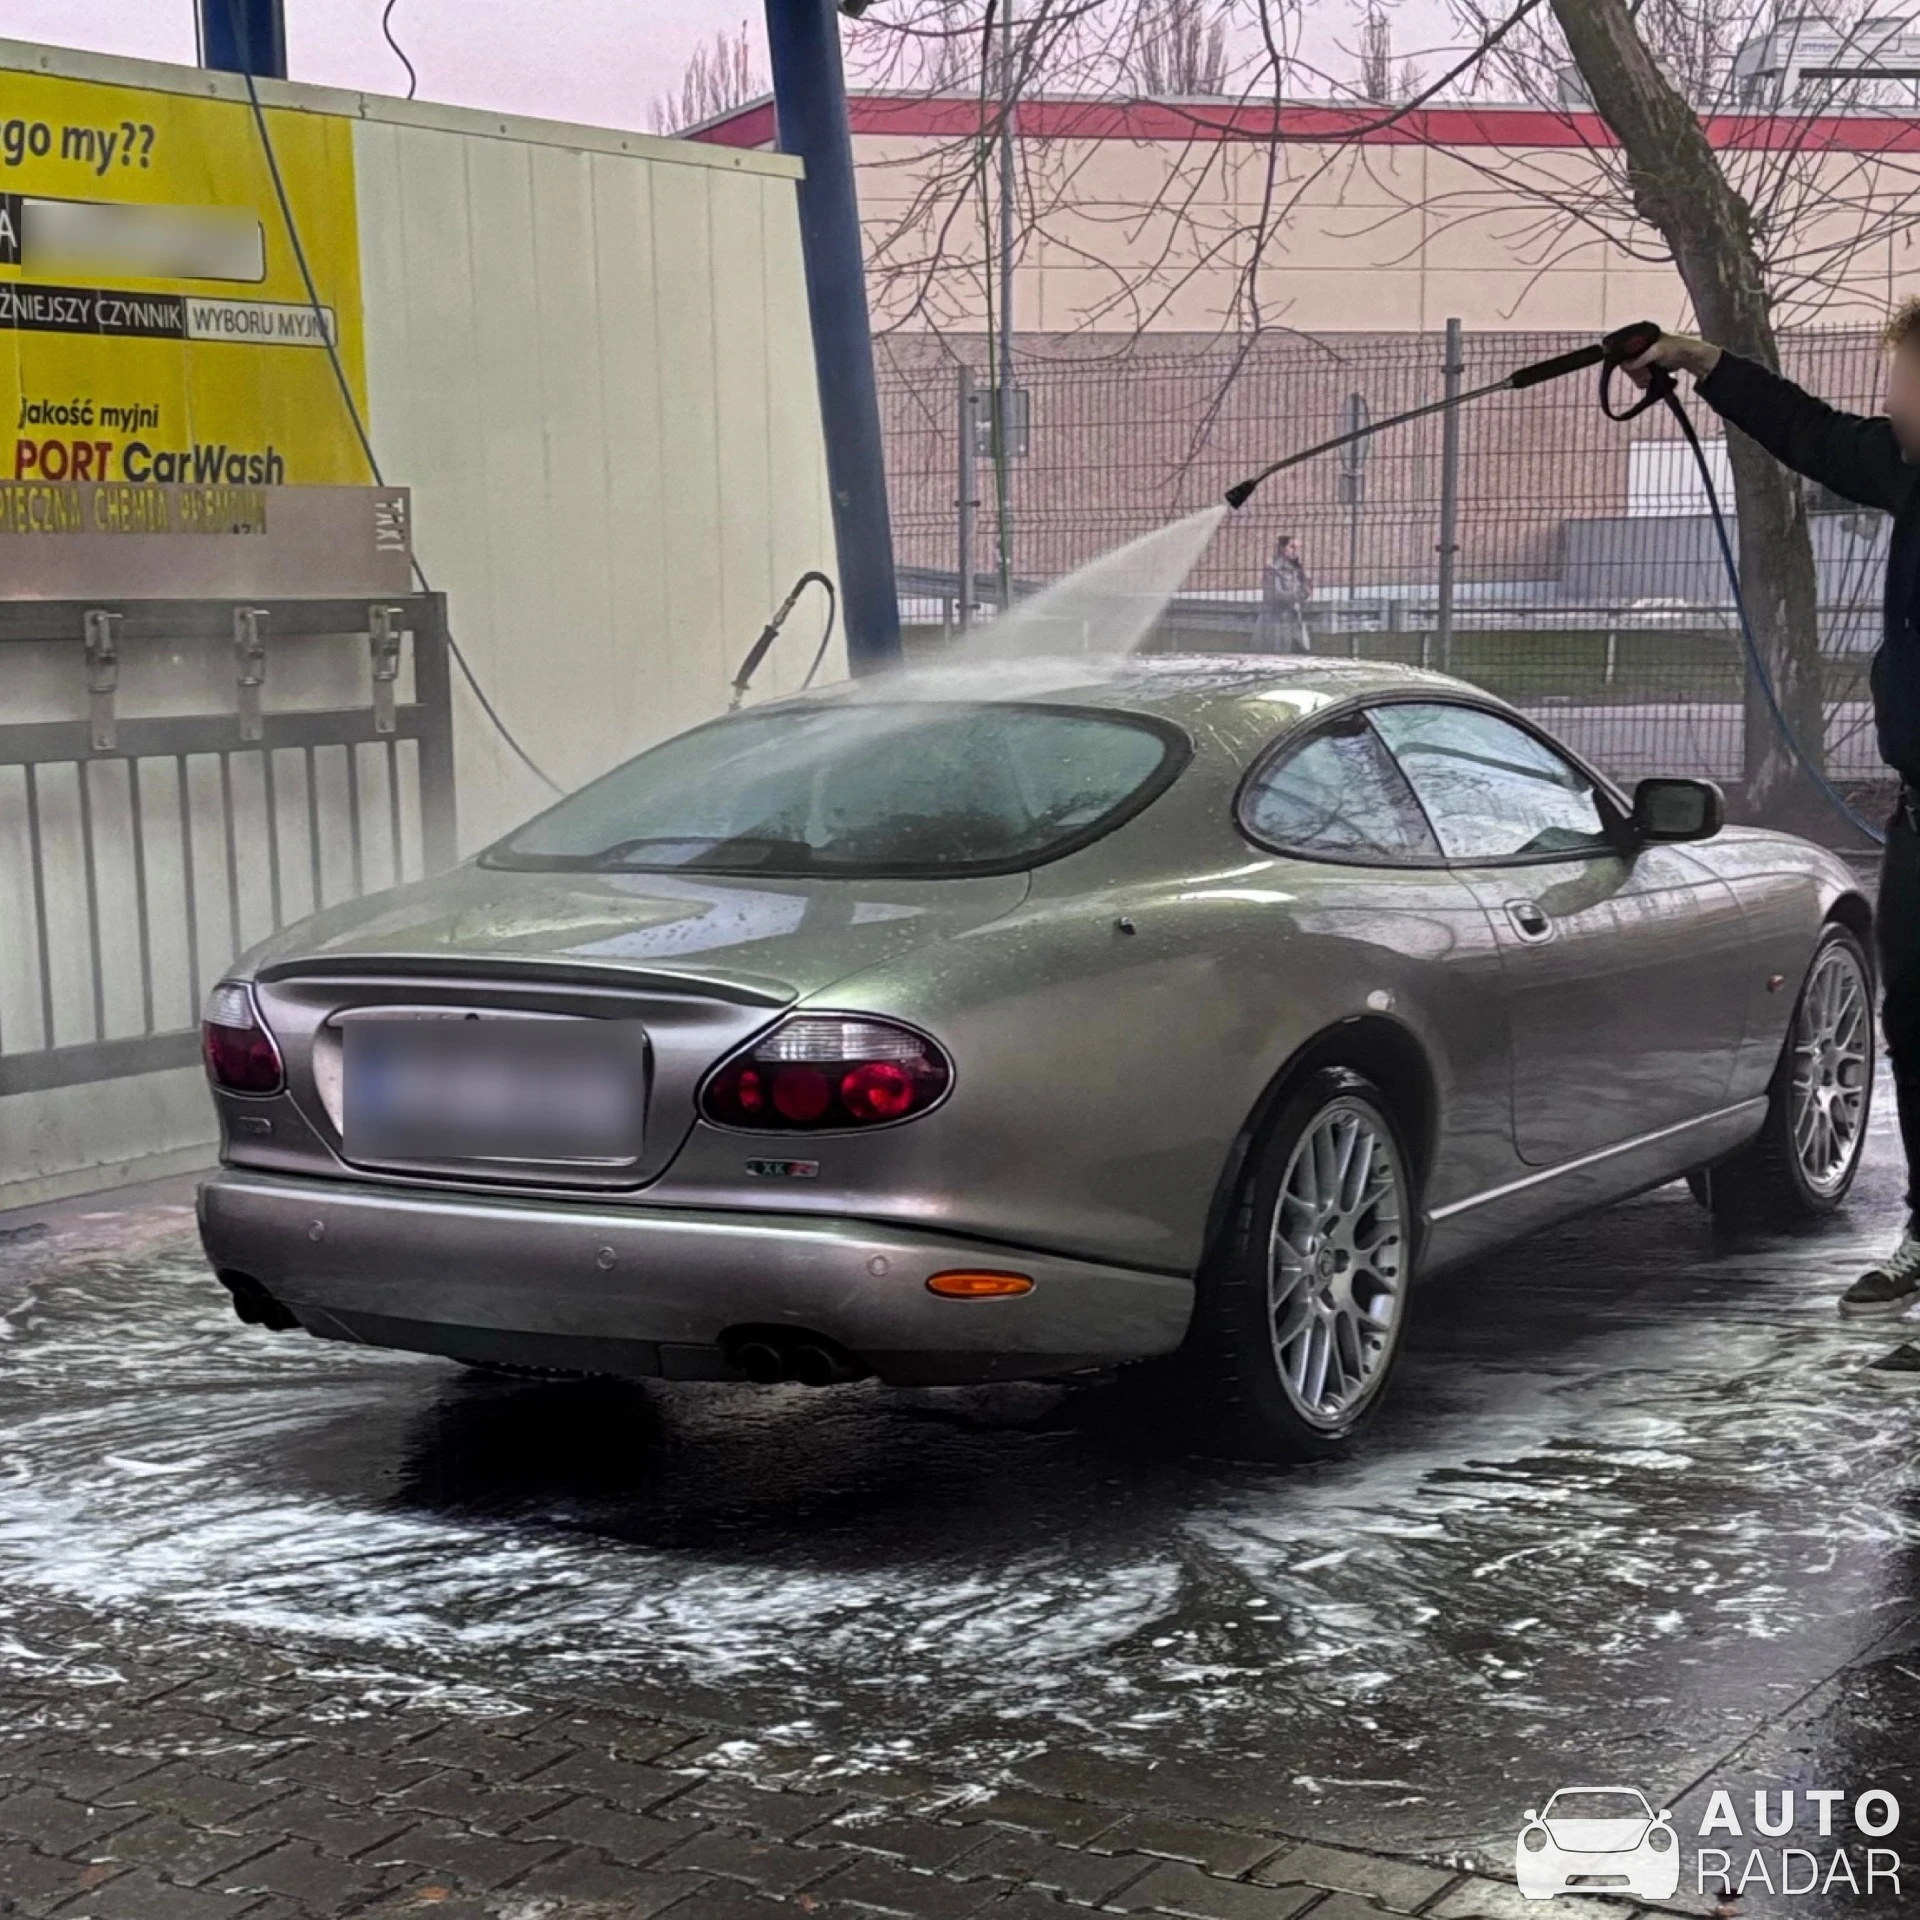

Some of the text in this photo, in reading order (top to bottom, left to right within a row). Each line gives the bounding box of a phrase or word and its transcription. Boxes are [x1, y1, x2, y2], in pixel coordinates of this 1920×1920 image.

[61, 121, 156, 176] my??
[0, 288, 90, 325] ŻNIEJSZY
[95, 300, 183, 331] CZYNNIK
[193, 306, 273, 336] WYBORU
[18, 397, 160, 433] jakość myjni
[15, 439, 284, 485] PORT CarWash
